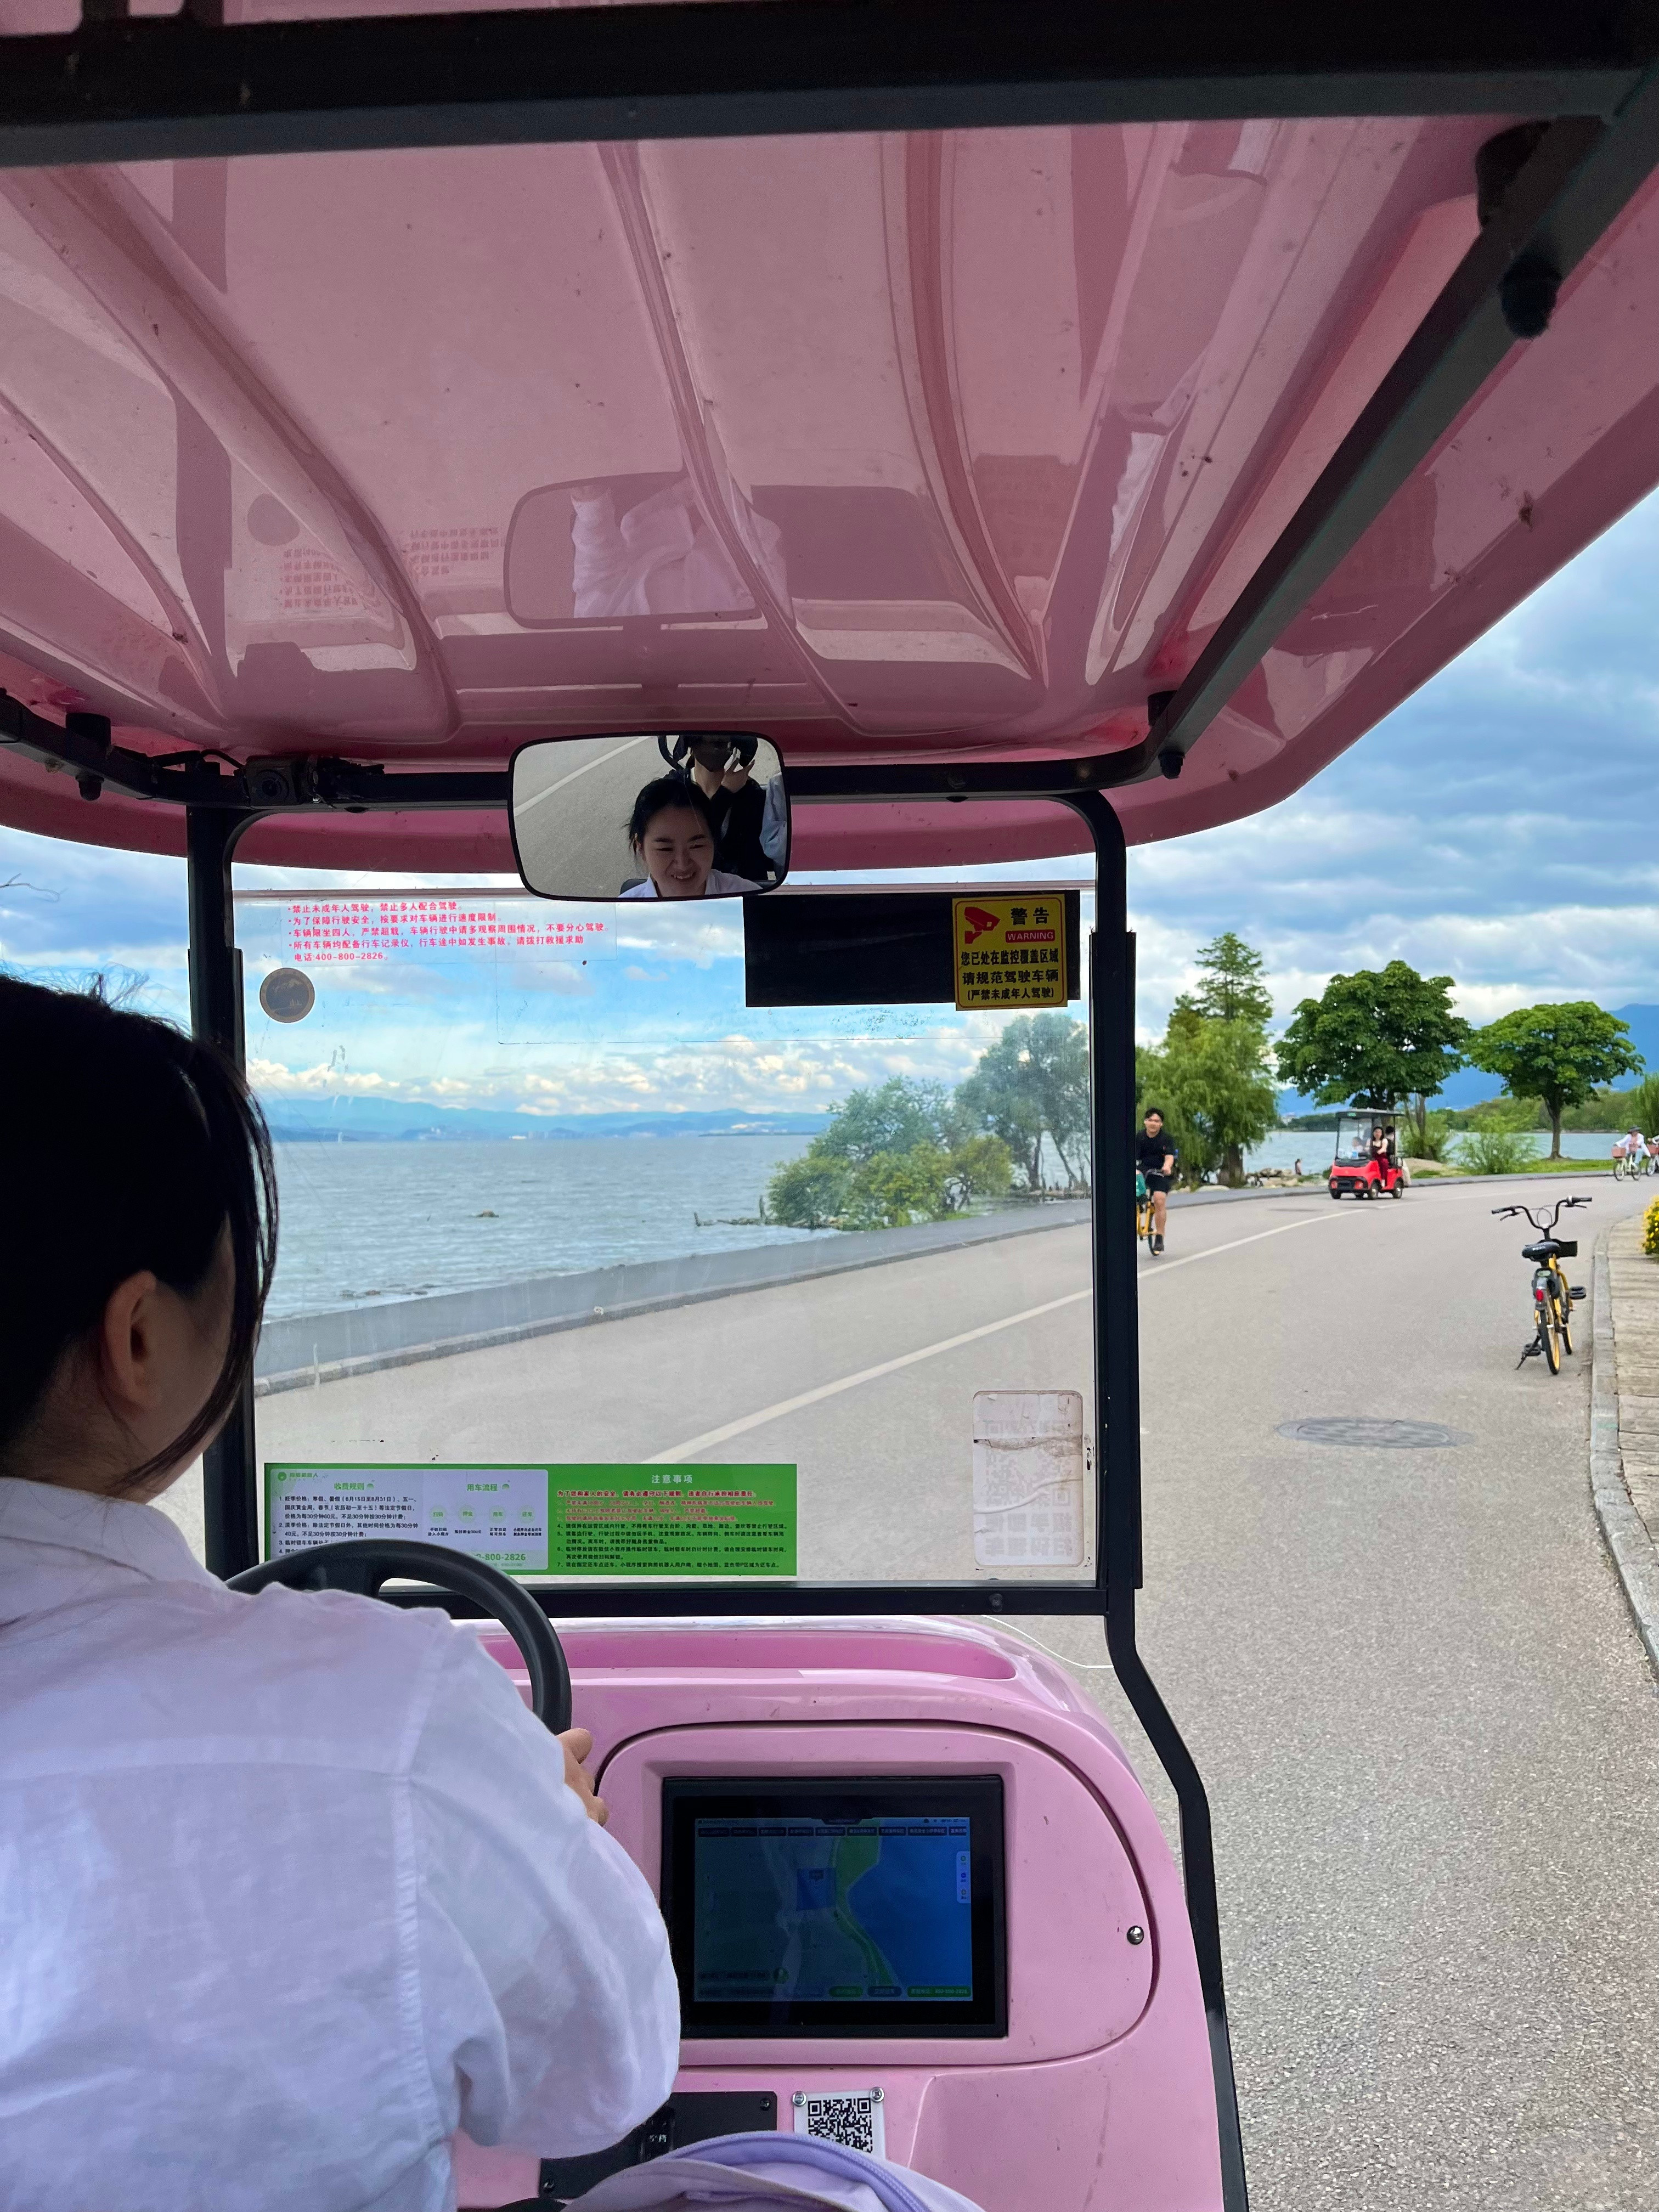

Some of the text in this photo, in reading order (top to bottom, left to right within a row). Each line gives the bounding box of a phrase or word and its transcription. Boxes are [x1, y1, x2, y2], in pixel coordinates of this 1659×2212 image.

[1010, 907, 1049, 925] 警告
[1007, 932, 1054, 940] WARNING
[961, 948, 1059, 966] 您已处在监控覆盖区域
[962, 969, 1059, 985] 请规范驾驶车辆
[652, 1475, 692, 1483] 注意事项
[334, 1482, 364, 1491] 收费规则
[467, 1483, 498, 1492] 用车流程
